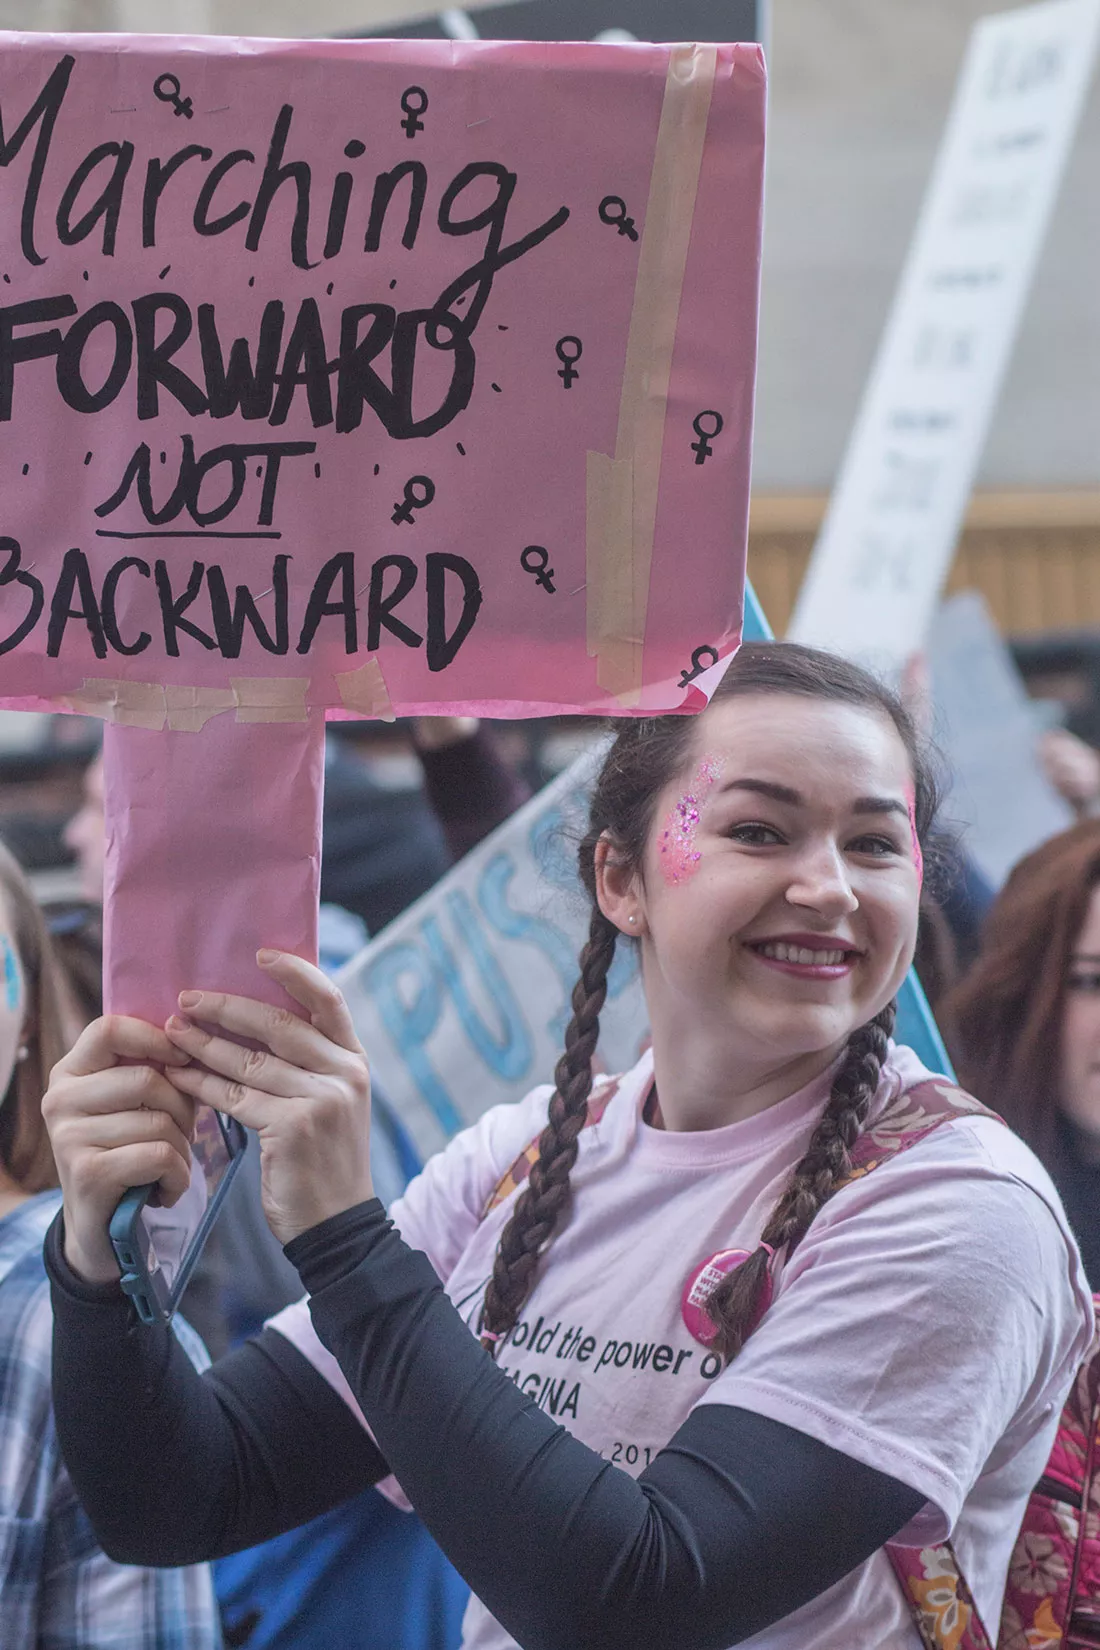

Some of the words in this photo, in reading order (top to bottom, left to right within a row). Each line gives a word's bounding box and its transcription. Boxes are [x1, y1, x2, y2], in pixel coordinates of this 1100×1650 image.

[0, 54, 570, 350] Marching
[0, 294, 477, 440] FORWARD
[94, 435, 316, 527] NOT
[0, 537, 484, 672] BACKWARD
[556, 1326, 596, 1363] the
[594, 1340, 694, 1375] power
[700, 1351, 722, 1380] o
[611, 1441, 652, 1466] 201
